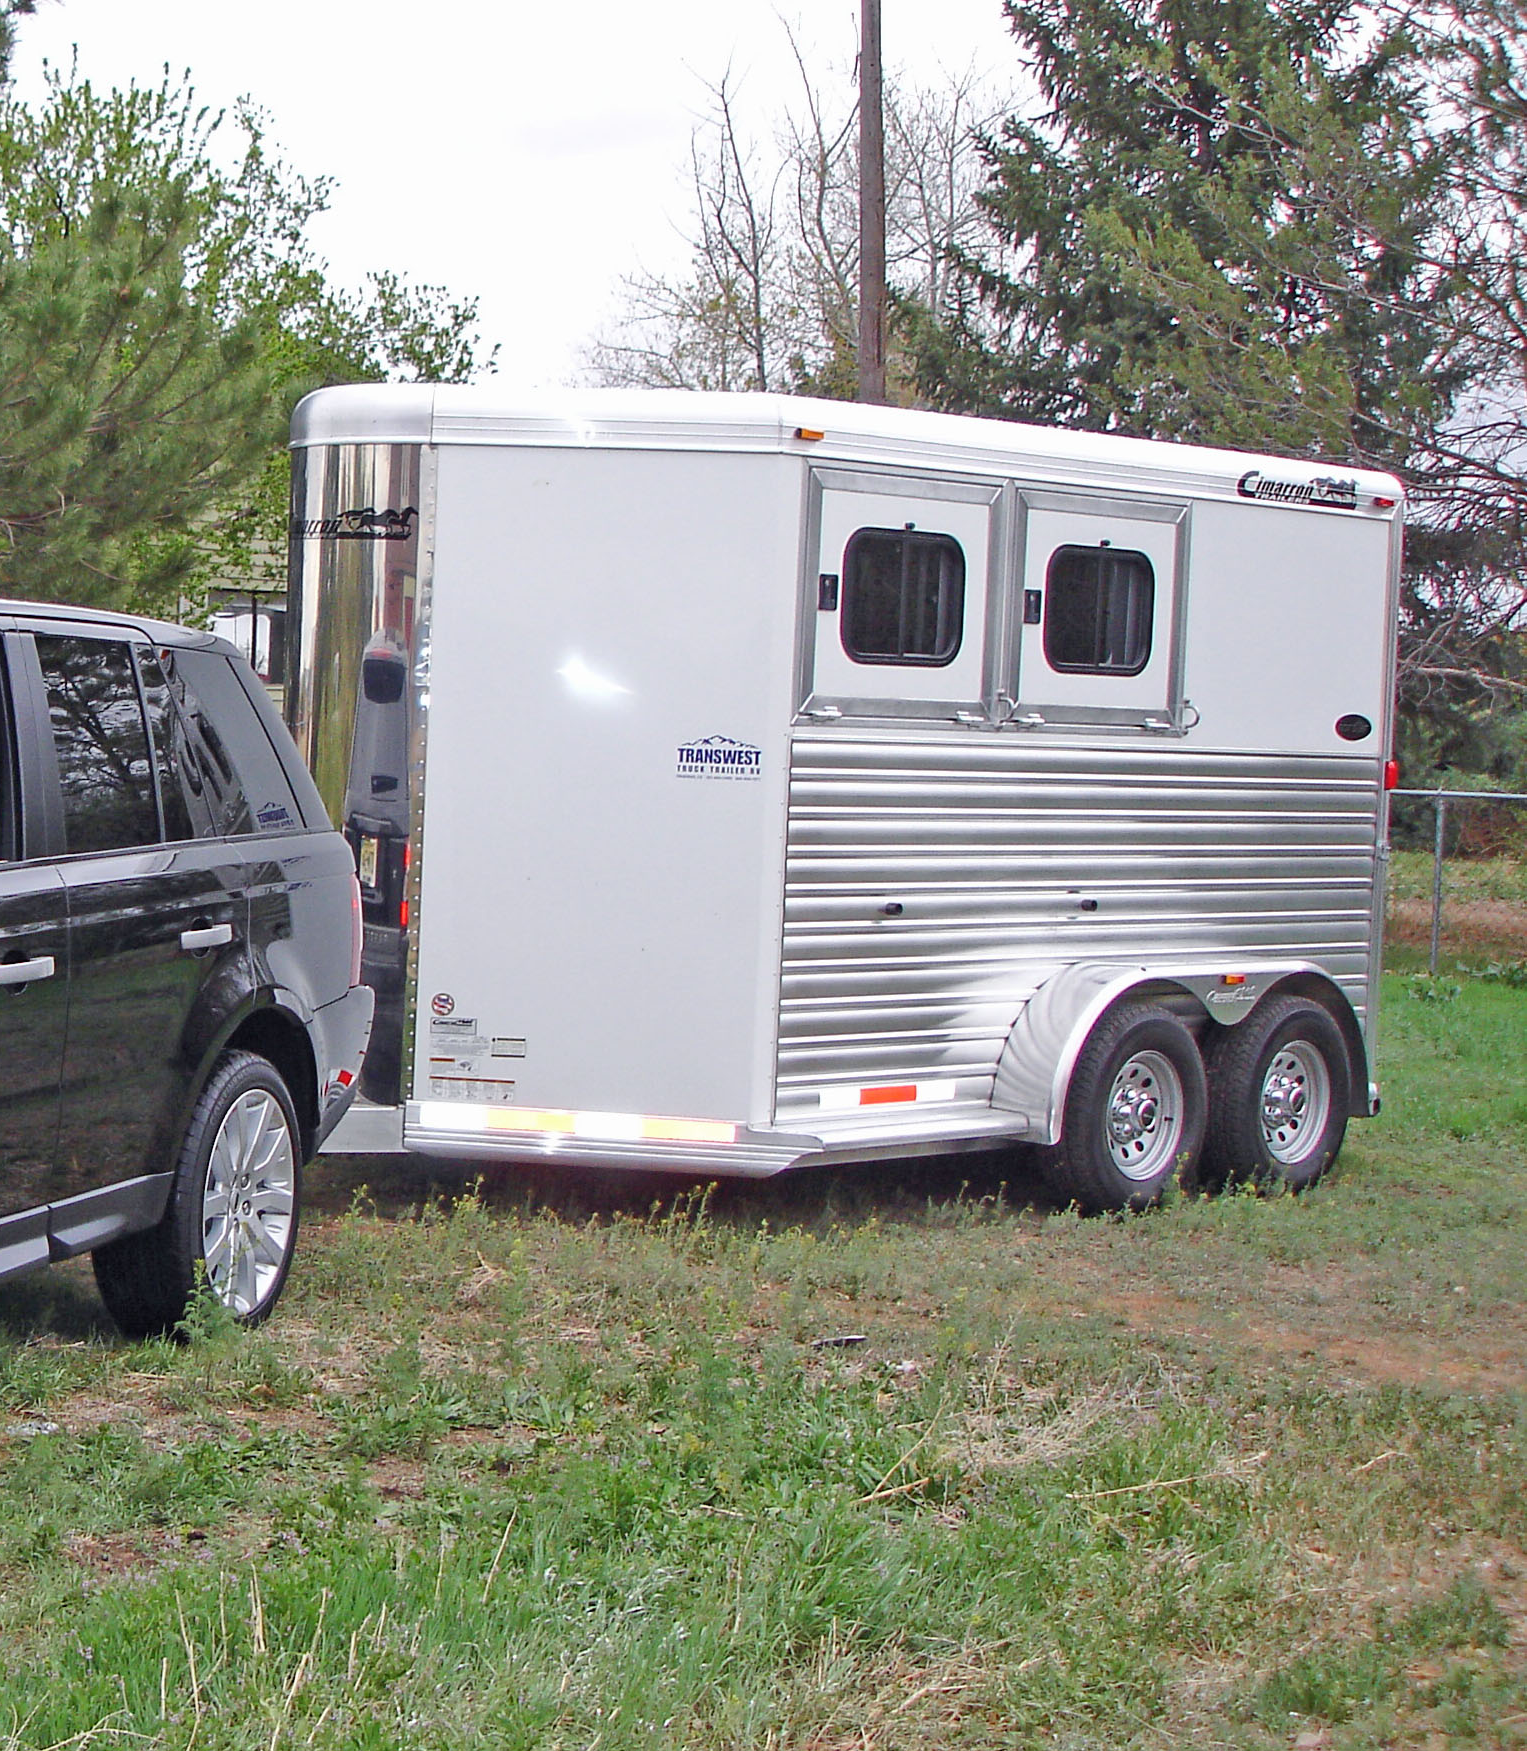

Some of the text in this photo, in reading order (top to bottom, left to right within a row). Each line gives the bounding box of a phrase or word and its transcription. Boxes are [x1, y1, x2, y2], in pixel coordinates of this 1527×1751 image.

[1237, 470, 1314, 498] Cimarron
[677, 748, 762, 765] TRANSWEST
[677, 765, 704, 773] TRUCK
[710, 766, 745, 774] TRAILER
